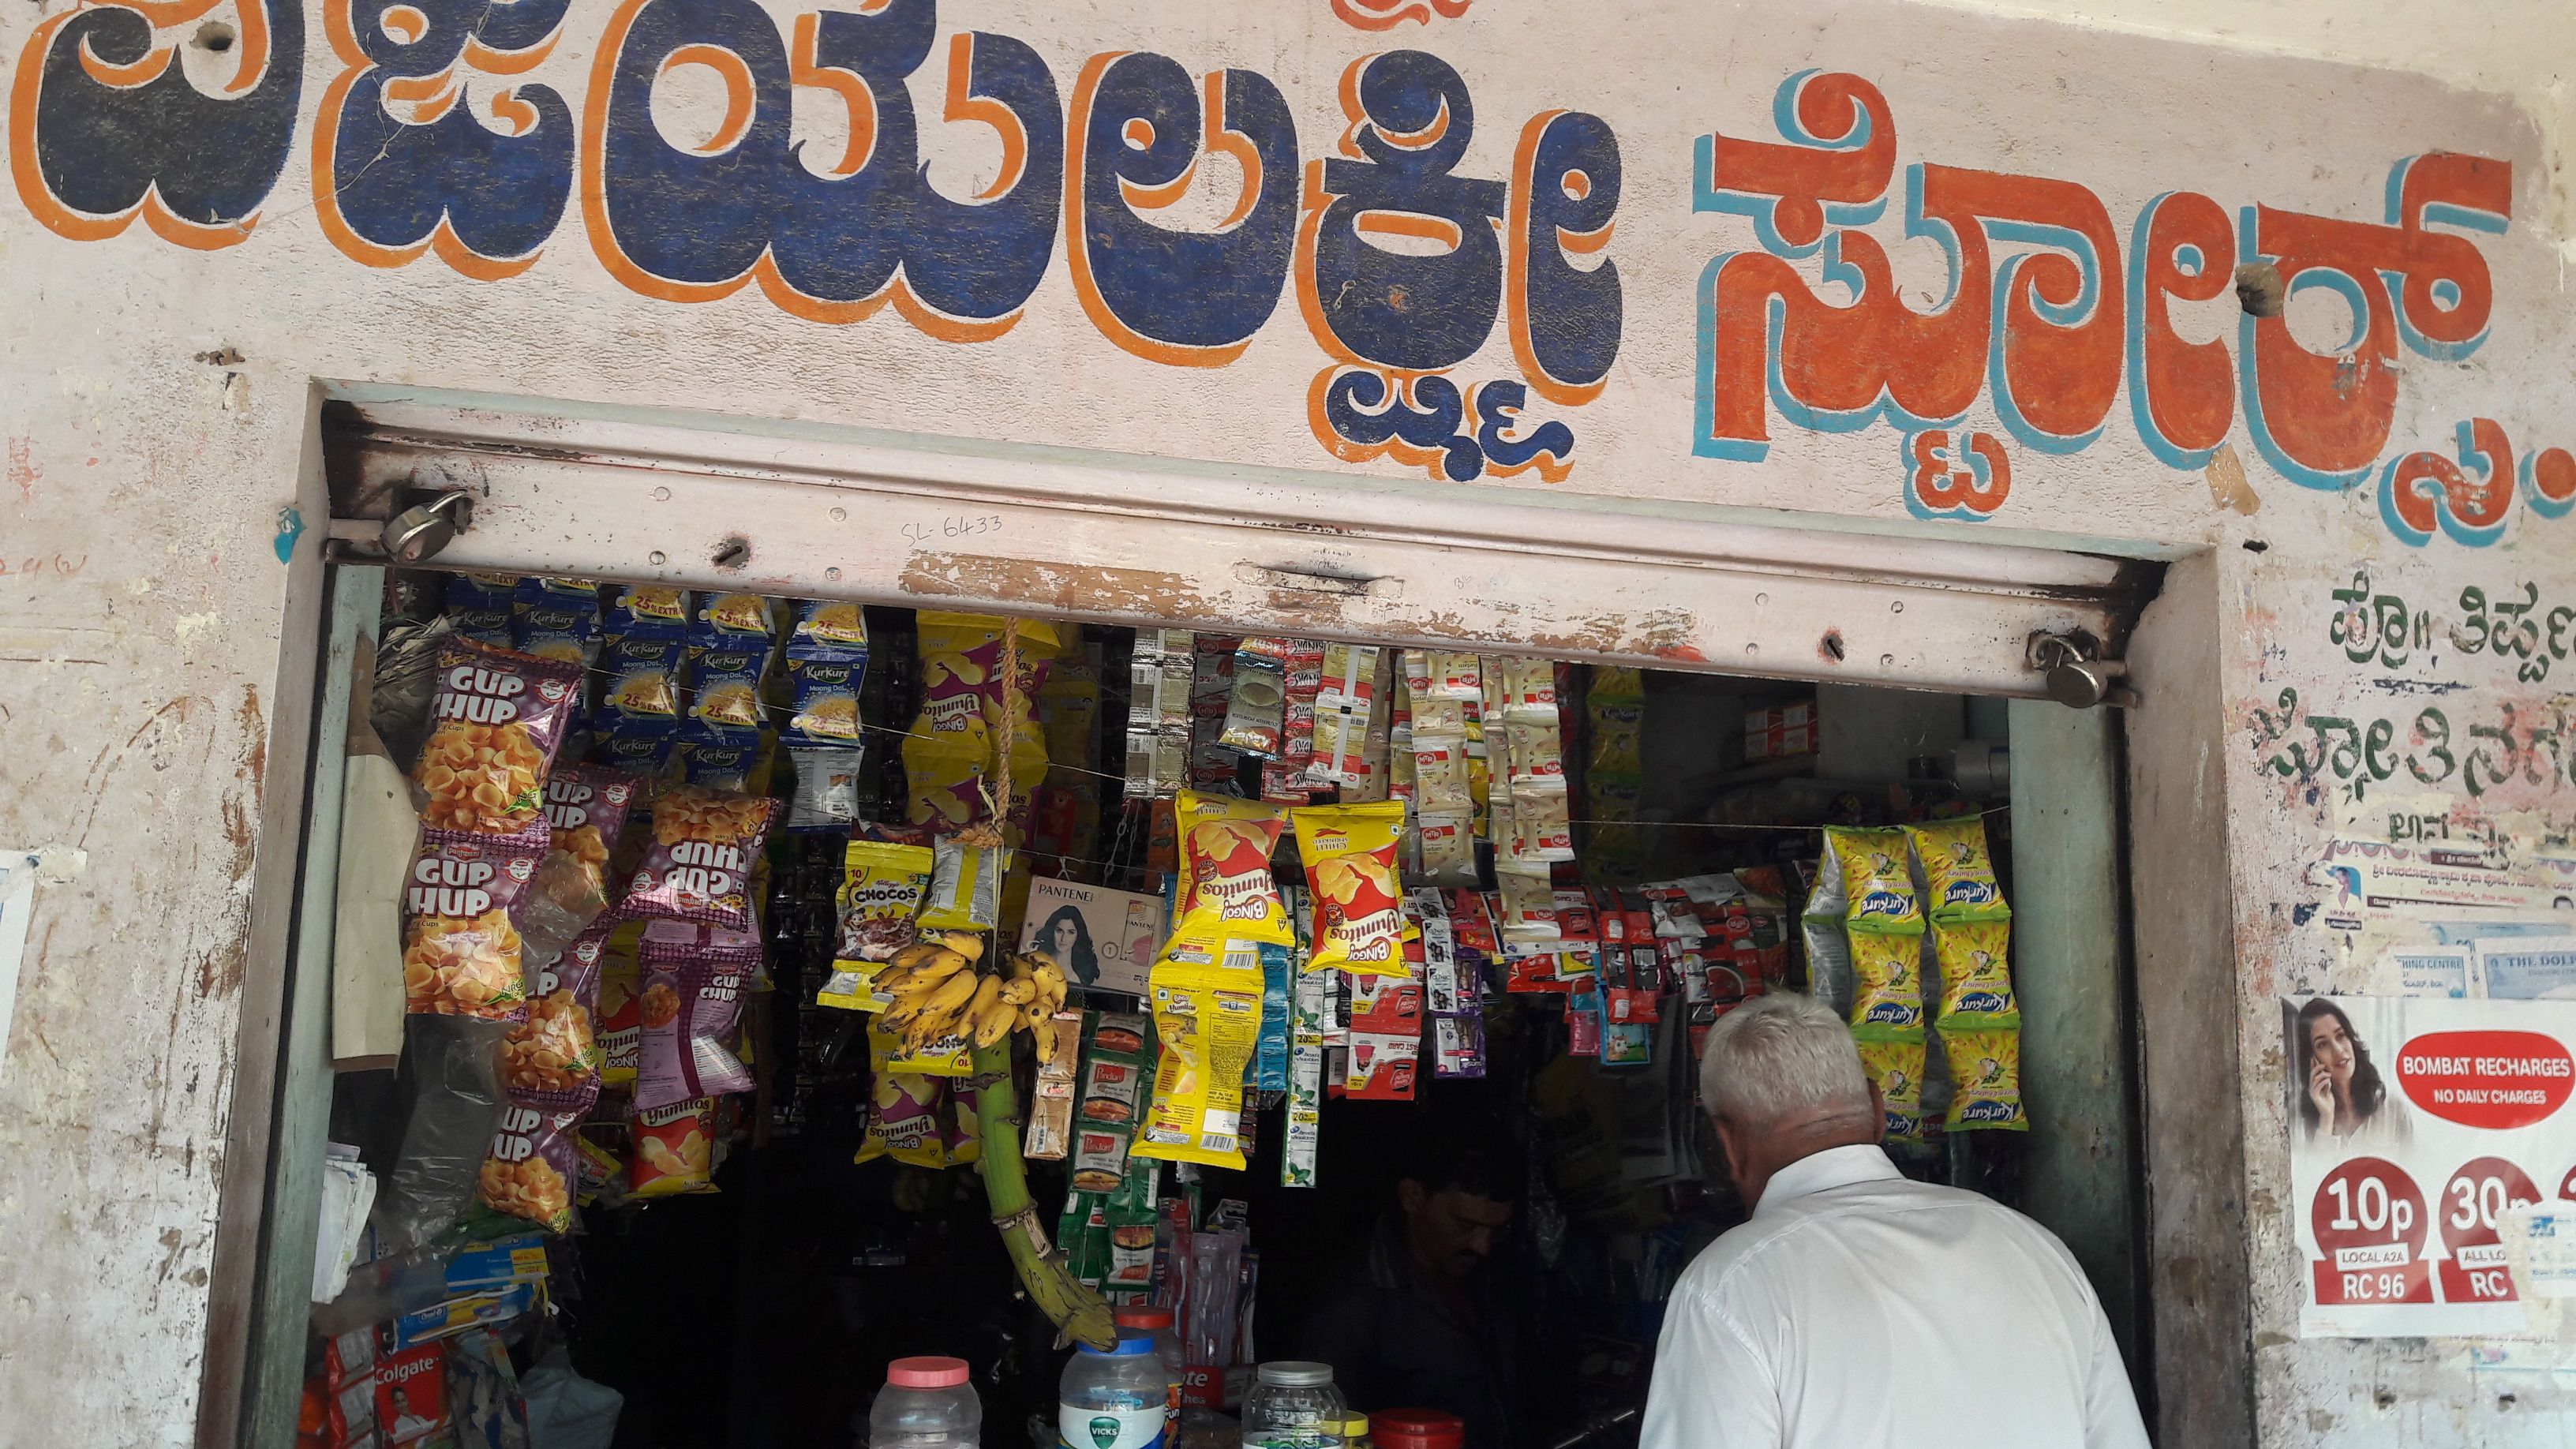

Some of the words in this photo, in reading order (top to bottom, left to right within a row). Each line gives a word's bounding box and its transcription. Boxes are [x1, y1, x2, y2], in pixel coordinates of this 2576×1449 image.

[943, 515, 1004, 537] 6433
[530, 610, 575, 626] Kurkure
[620, 641, 666, 657] Kurkure
[703, 653, 748, 669] Kurkure
[449, 665, 526, 698] GUP
[805, 666, 851, 680] Kurkure
[932, 714, 968, 733] BINGO!
[696, 749, 741, 762] Kurkure
[545, 780, 593, 805] UP
[414, 858, 496, 887] GUP
[664, 865, 732, 895] GUP
[854, 888, 918, 903] CHOCOS
[1039, 883, 1091, 903] PANTENE
[1203, 872, 1275, 899] Yumitos
[1944, 879, 1993, 904] Kurkure
[1220, 899, 1264, 923] BINGO!
[1861, 892, 1909, 916] Kurkure
[1329, 909, 1399, 942] Yumitos
[1346, 942, 1390, 963] BINGO!
[712, 975, 739, 989] GUP
[699, 987, 737, 1002] CHUP
[1956, 991, 2006, 1012] Kurkure
[1866, 1003, 1915, 1024] Kurkure
[2402, 1054, 2470, 1076] BOMBAT
[2474, 1055, 2571, 1079] RECHARGES
[2433, 1089, 2454, 1104] NO
[2457, 1089, 2488, 1105] DAILY
[2490, 1089, 2547, 1106] CHARGES
[1962, 1099, 2014, 1121] Kurkure
[869, 1116, 930, 1137] Yumitos
[1886, 1114, 1915, 1135] Kurk
[885, 1136, 923, 1151] BINGO!
[2327, 1176, 2414, 1241] 10p
[2341, 1250, 2382, 1264] LOCAL
[2342, 1273, 2375, 1300] RC
[2377, 1272, 2406, 1299] 96
[2469, 1270, 2508, 1297] RC
[376, 1356, 435, 1386] Colgate
[1090, 1426, 1118, 1436] VICKS
